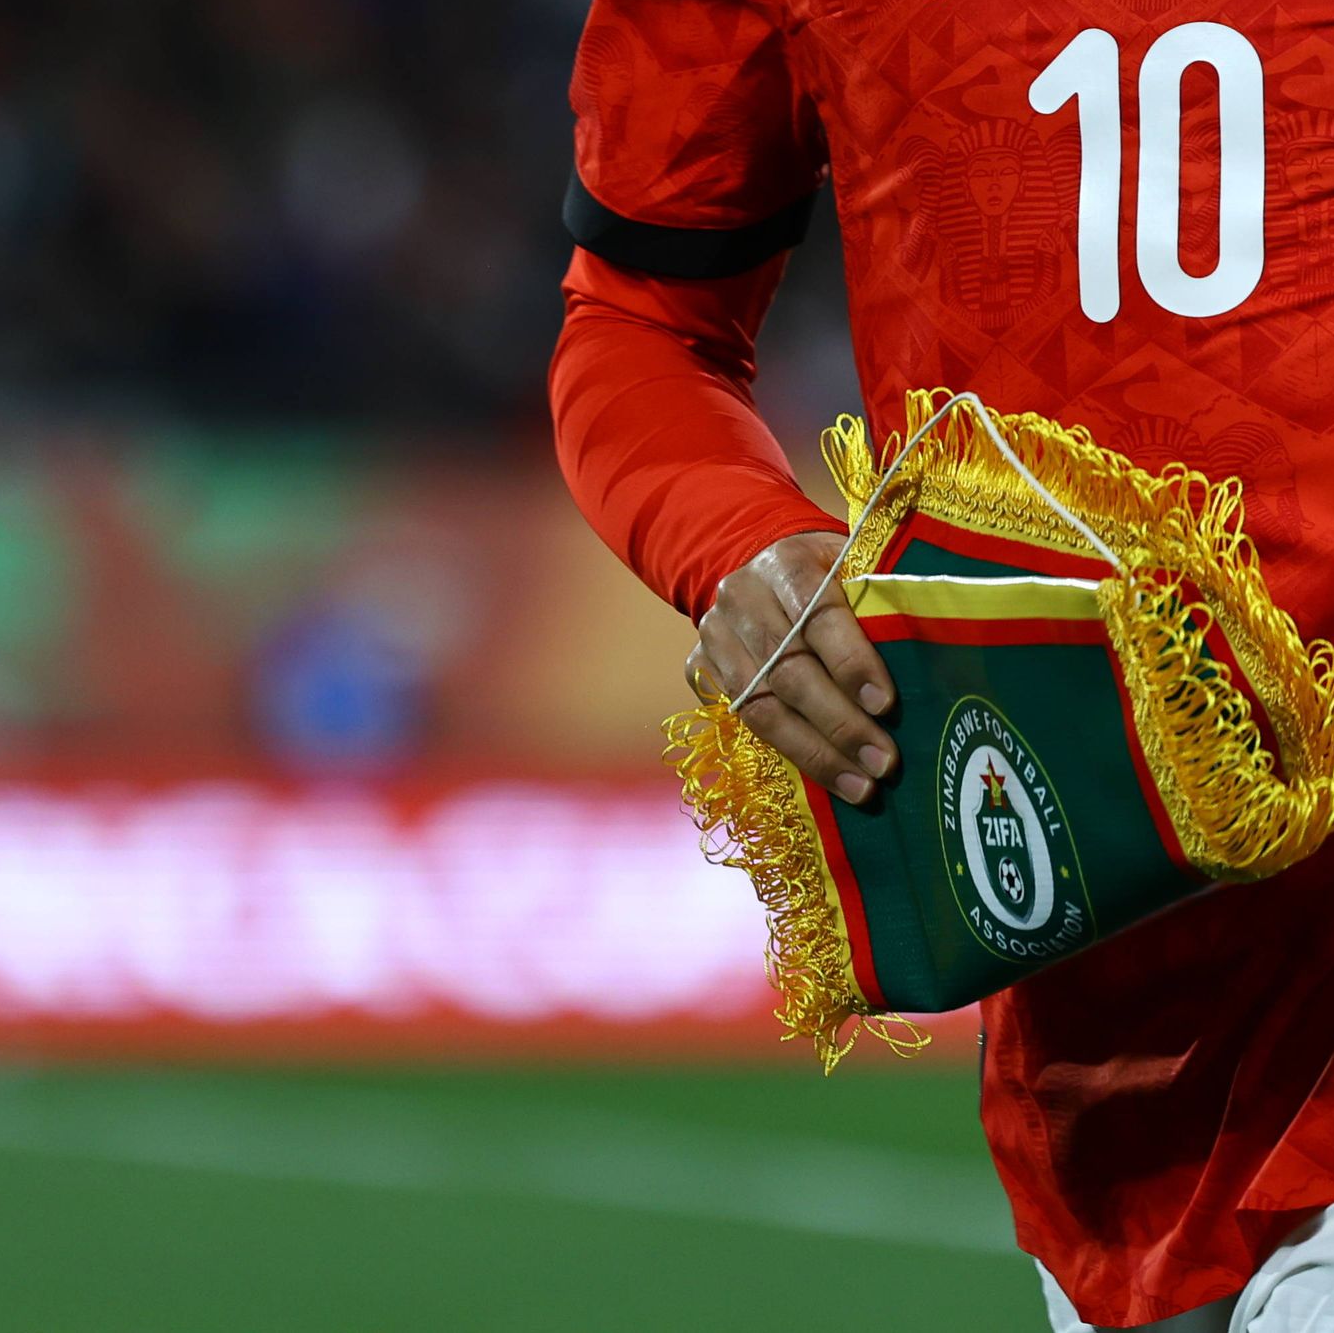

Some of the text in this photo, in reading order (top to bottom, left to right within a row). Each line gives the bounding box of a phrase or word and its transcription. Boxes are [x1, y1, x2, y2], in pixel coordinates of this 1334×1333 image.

[1028, 21, 1265, 324] 10
[943, 707, 1062, 837] ZIMBABWE FOOTBALL
[982, 816, 1024, 848] ZIFA
[969, 900, 1082, 958] ASSOCIATION
